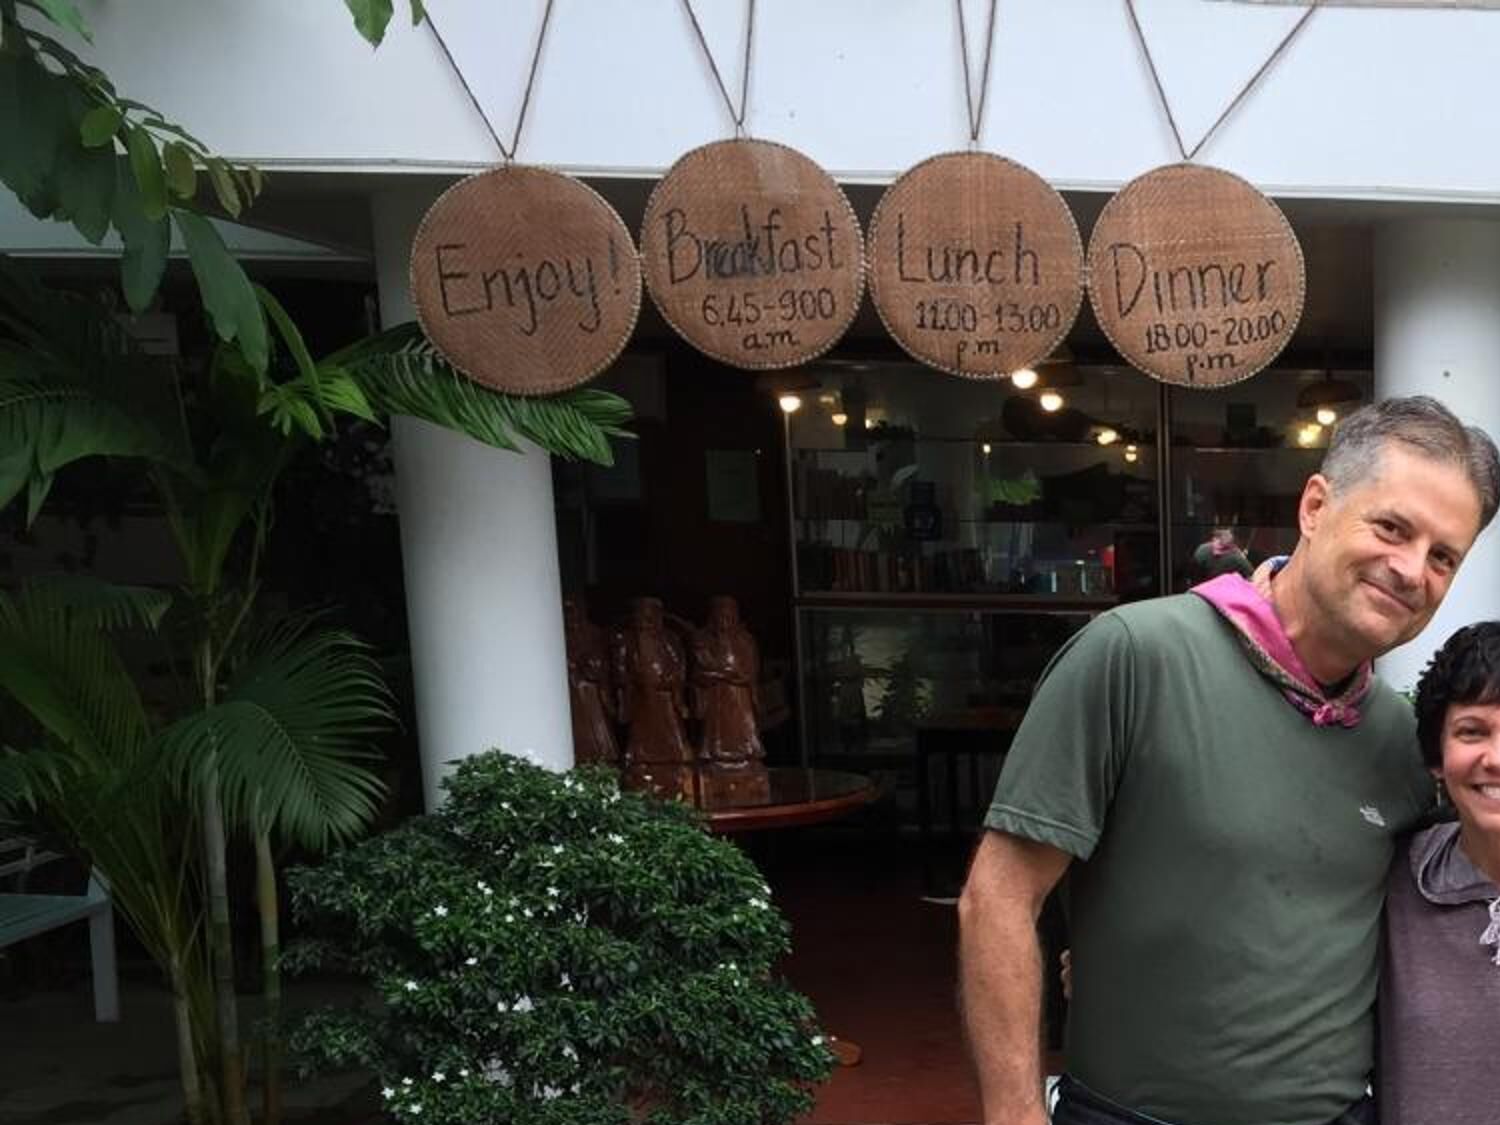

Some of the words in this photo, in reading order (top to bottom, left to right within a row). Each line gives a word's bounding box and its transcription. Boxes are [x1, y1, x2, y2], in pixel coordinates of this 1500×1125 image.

[435, 237, 621, 335] Enjoy!
[898, 212, 1041, 286] Lunch
[1107, 241, 1279, 320] Dinner
